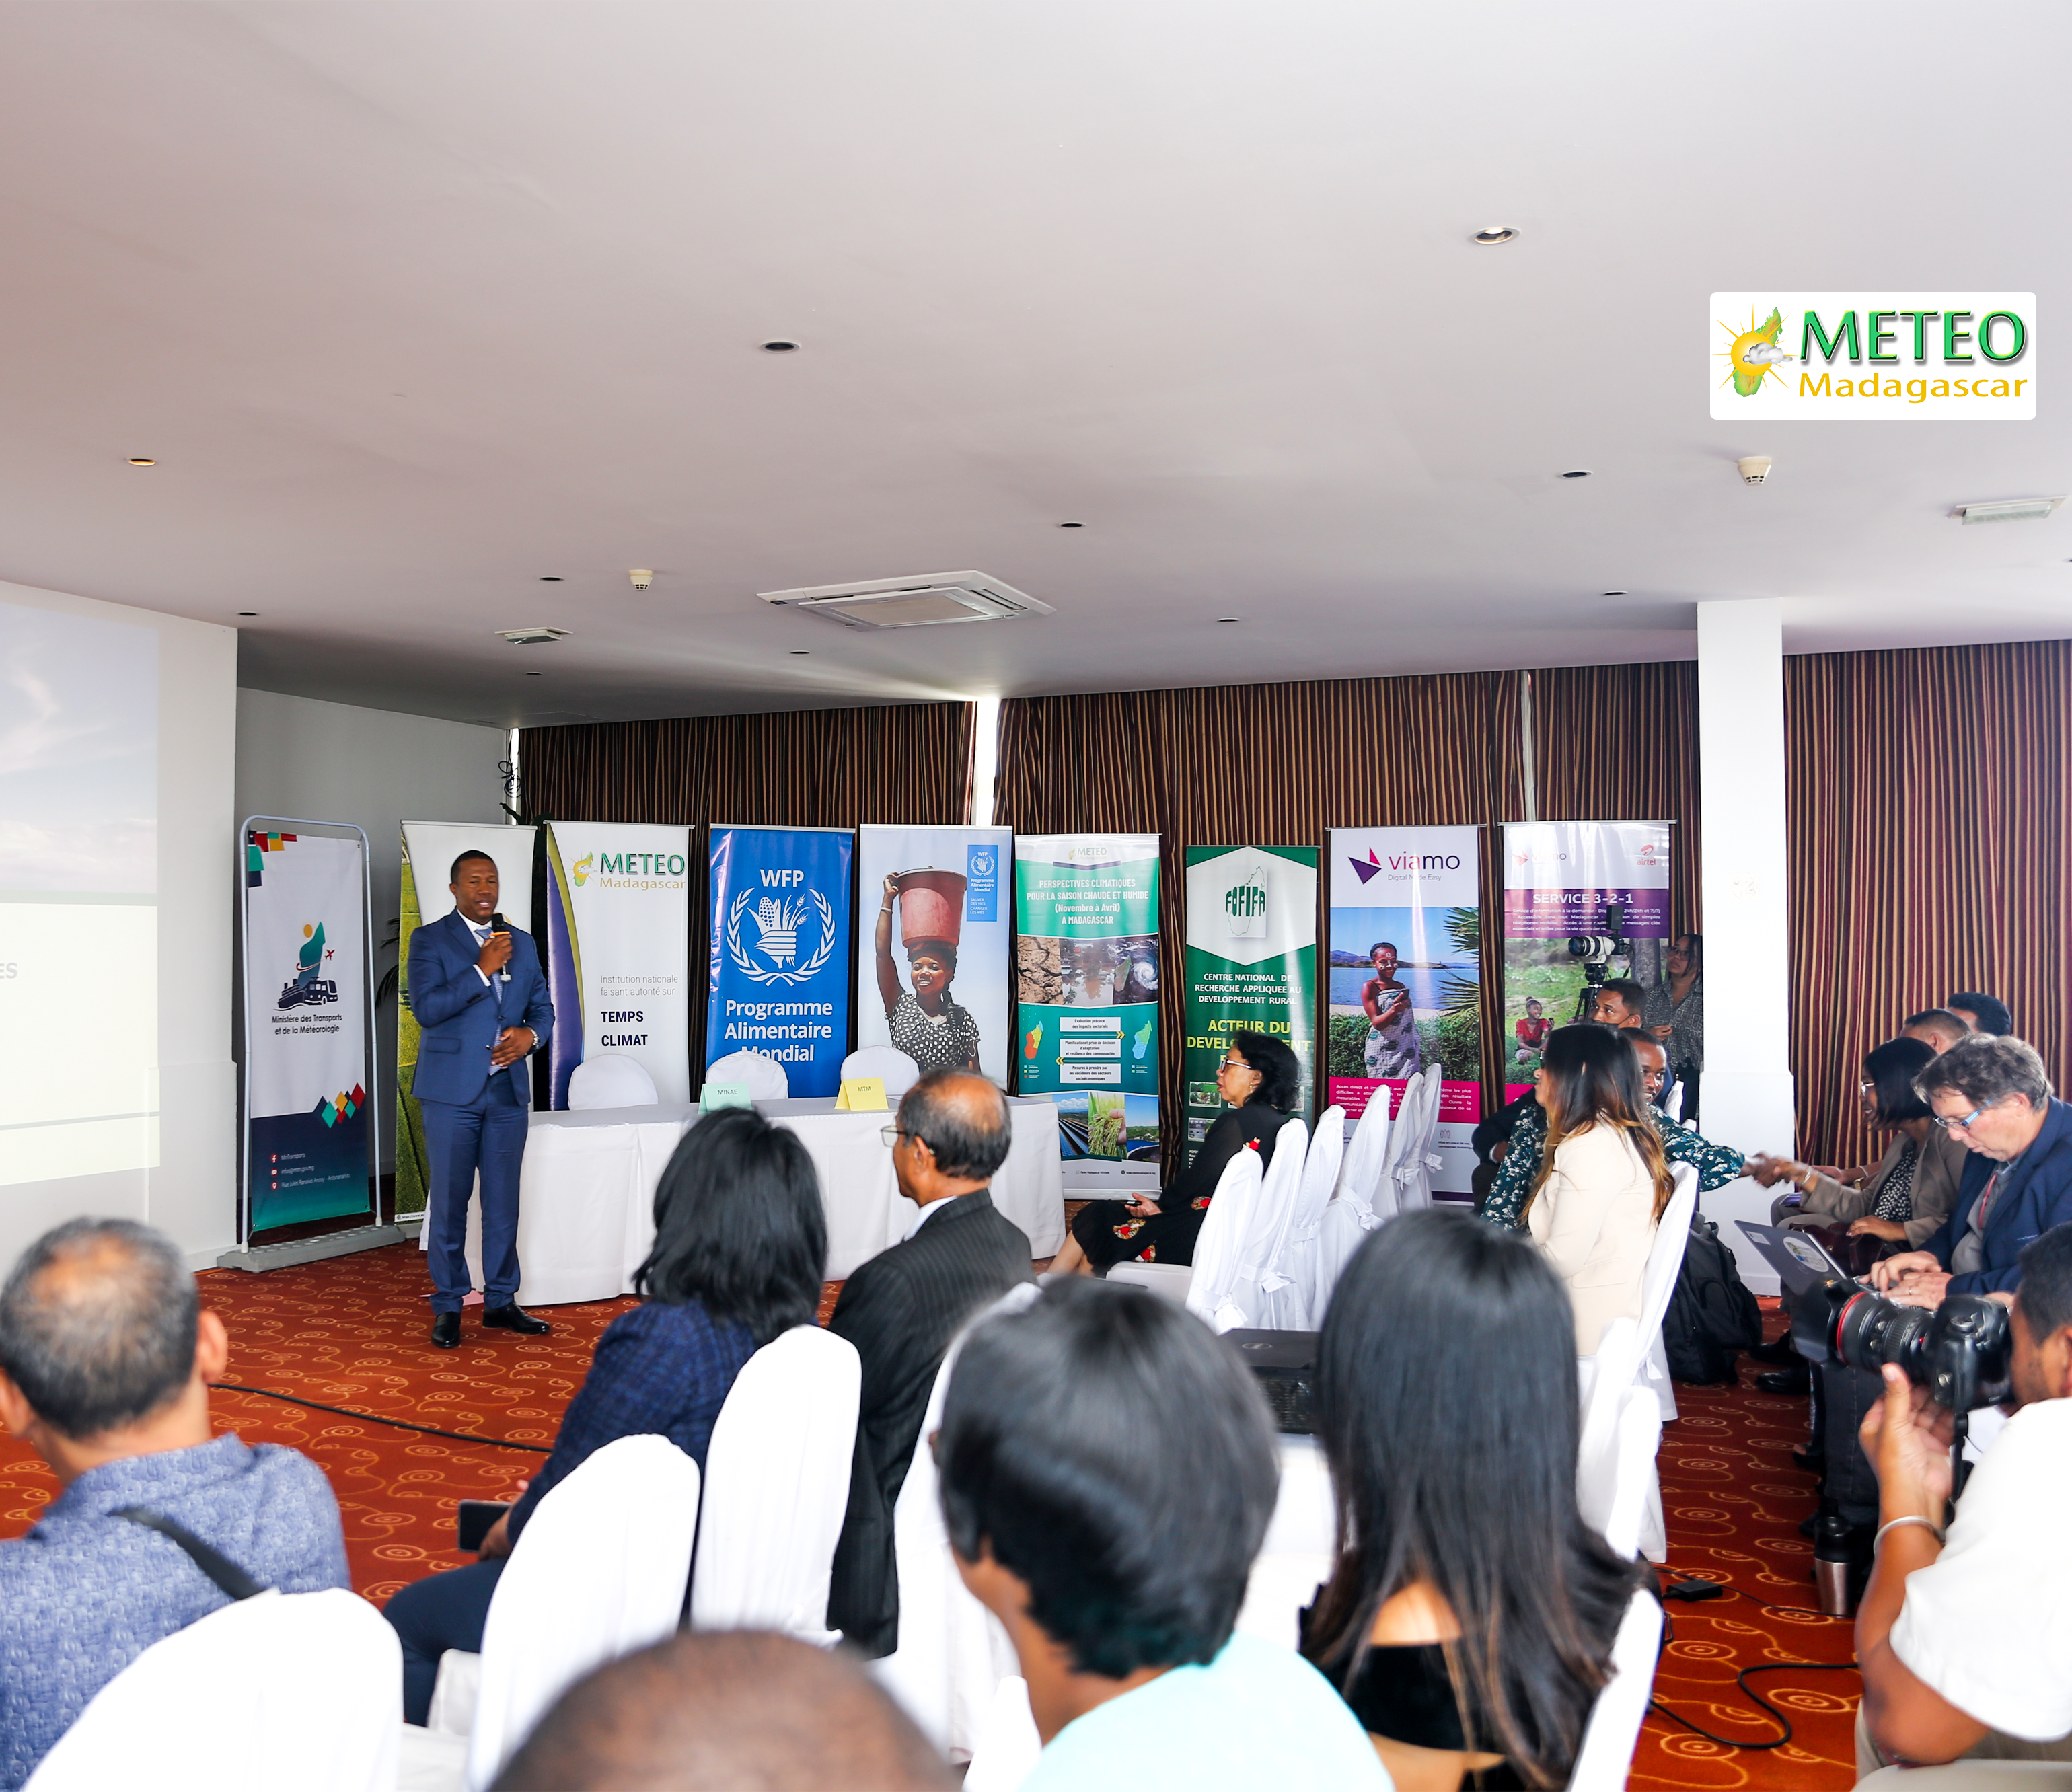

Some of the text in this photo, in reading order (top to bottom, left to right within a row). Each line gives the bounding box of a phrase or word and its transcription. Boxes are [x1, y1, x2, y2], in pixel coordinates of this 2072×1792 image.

[1078, 848, 1107, 856] METEO
[600, 853, 685, 874] METEO
[1389, 851, 1460, 870] viamo
[760, 869, 805, 887] WFP
[600, 878, 685, 891] Madagascar
[1039, 879, 1136, 888] PERSPECTIVES CLIMATIQUES
[1027, 891, 1149, 900] POUR LA SAISON CHAUDE ET HUMIDE
[1226, 885, 1265, 916] FOFIFA
[1532, 893, 1633, 904] SERVICE 3-2-1
[1055, 903, 1121, 913] (Novembre à Avril)
[1062, 916, 1114, 924] A MADAGASCAR
[601, 975, 678, 983] Institution nationale
[1235, 974, 1275, 982] NATIONAL
[601, 986, 628, 996] faisant
[630, 986, 660, 996] autorité
[1242, 985, 1288, 994] APPLIQUEE
[1199, 996, 1297, 1005] DEVELOPPEMENT RURAL
[725, 1000, 833, 1021] Programme
[272, 1014, 299, 1023] Ministère
[313, 1014, 342, 1022] Transports
[601, 1010, 644, 1022] TEMPS
[283, 1026, 291, 1035] de
[299, 1025, 340, 1034] Météorologie
[724, 1021, 832, 1040] Alimentaire
[1208, 1020, 1290, 1034] ACTEUR DU
[601, 1035, 648, 1047] CLIMAT
